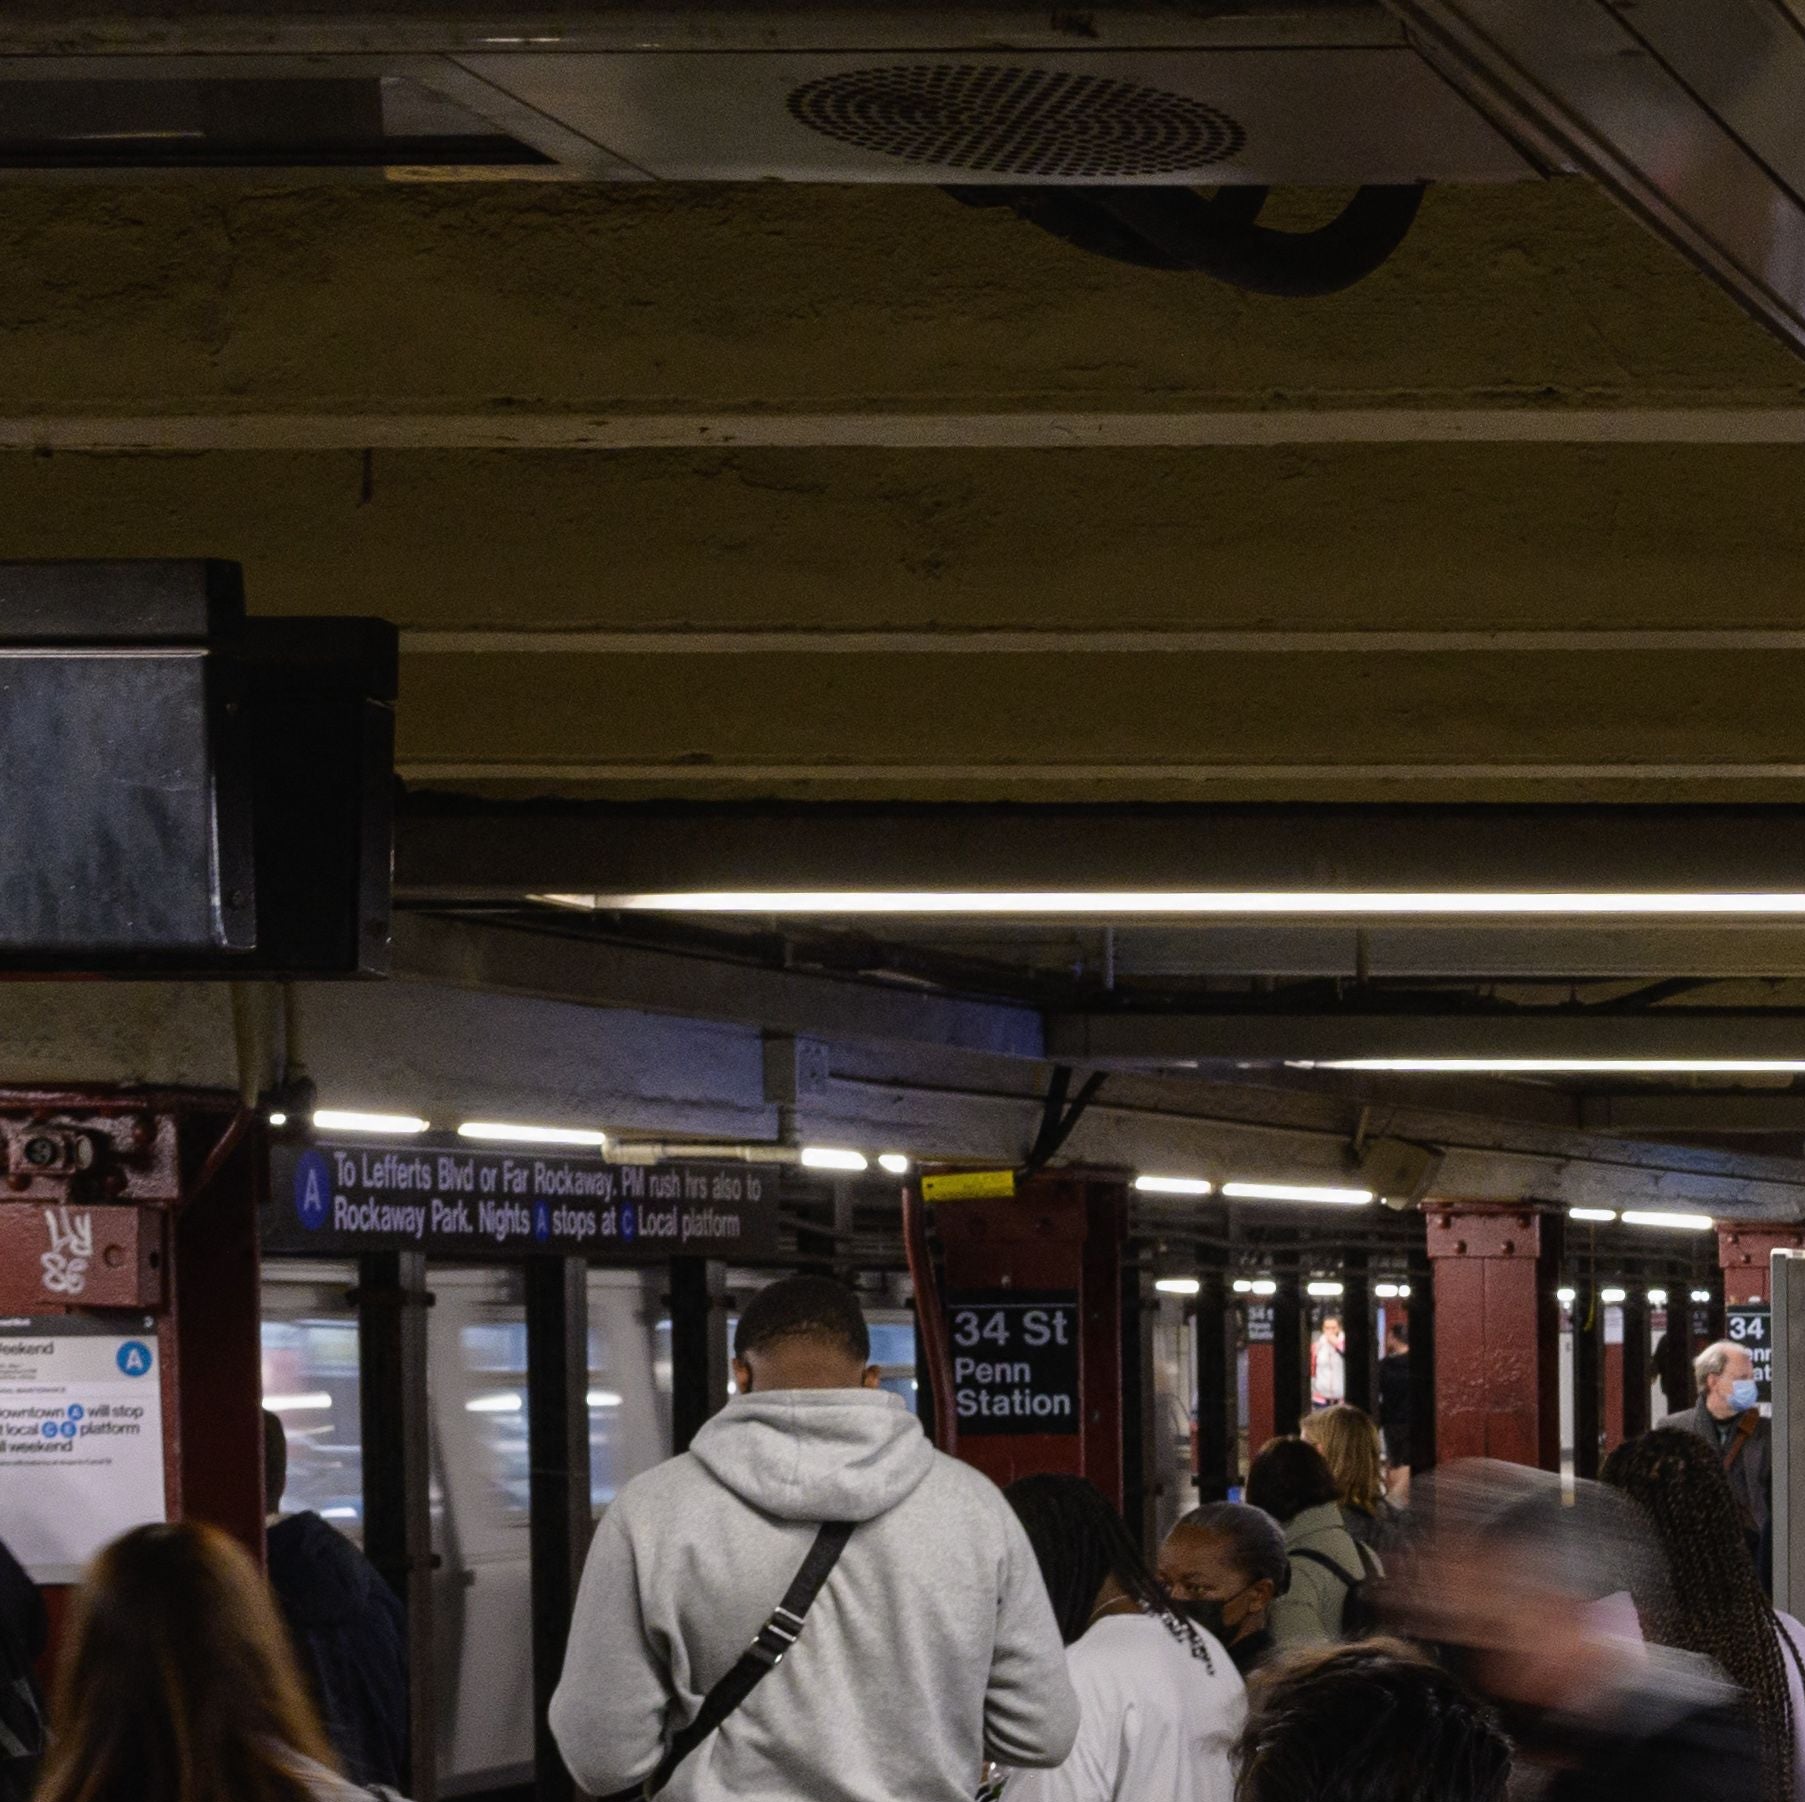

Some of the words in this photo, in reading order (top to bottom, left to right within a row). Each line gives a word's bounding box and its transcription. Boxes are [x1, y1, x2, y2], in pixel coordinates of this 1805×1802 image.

[334, 1150, 356, 1187] To
[362, 1152, 432, 1190] Lefferts
[438, 1156, 474, 1192] Blvd
[480, 1165, 498, 1192] or
[503, 1159, 528, 1193] Far
[622, 1165, 645, 1197] PM
[649, 1168, 680, 1199] rush
[685, 1169, 708, 1199] hrs
[712, 1170, 742, 1200] also
[747, 1173, 761, 1201] to
[304, 1168, 322, 1212] A
[334, 1194, 425, 1240] Rockaway
[431, 1198, 473, 1234] Park.
[478, 1200, 531, 1242] Nights
[552, 1204, 596, 1242] stops
[601, 1205, 617, 1235] at
[637, 1205, 678, 1236] Local
[682, 1205, 741, 1243] platform
[954, 1310, 1010, 1346] 34
[1022, 1310, 1069, 1346] St
[1729, 1317, 1764, 1340] 34
[0, 1342, 54, 1355] eekend
[955, 1357, 1031, 1384] Penn
[0, 1406, 64, 1418] owntown
[87, 1405, 110, 1418] will
[112, 1405, 144, 1420] stop
[956, 1388, 1071, 1416] Station
[80, 1421, 140, 1437] platform
[9, 1440, 73, 1452] weekend
